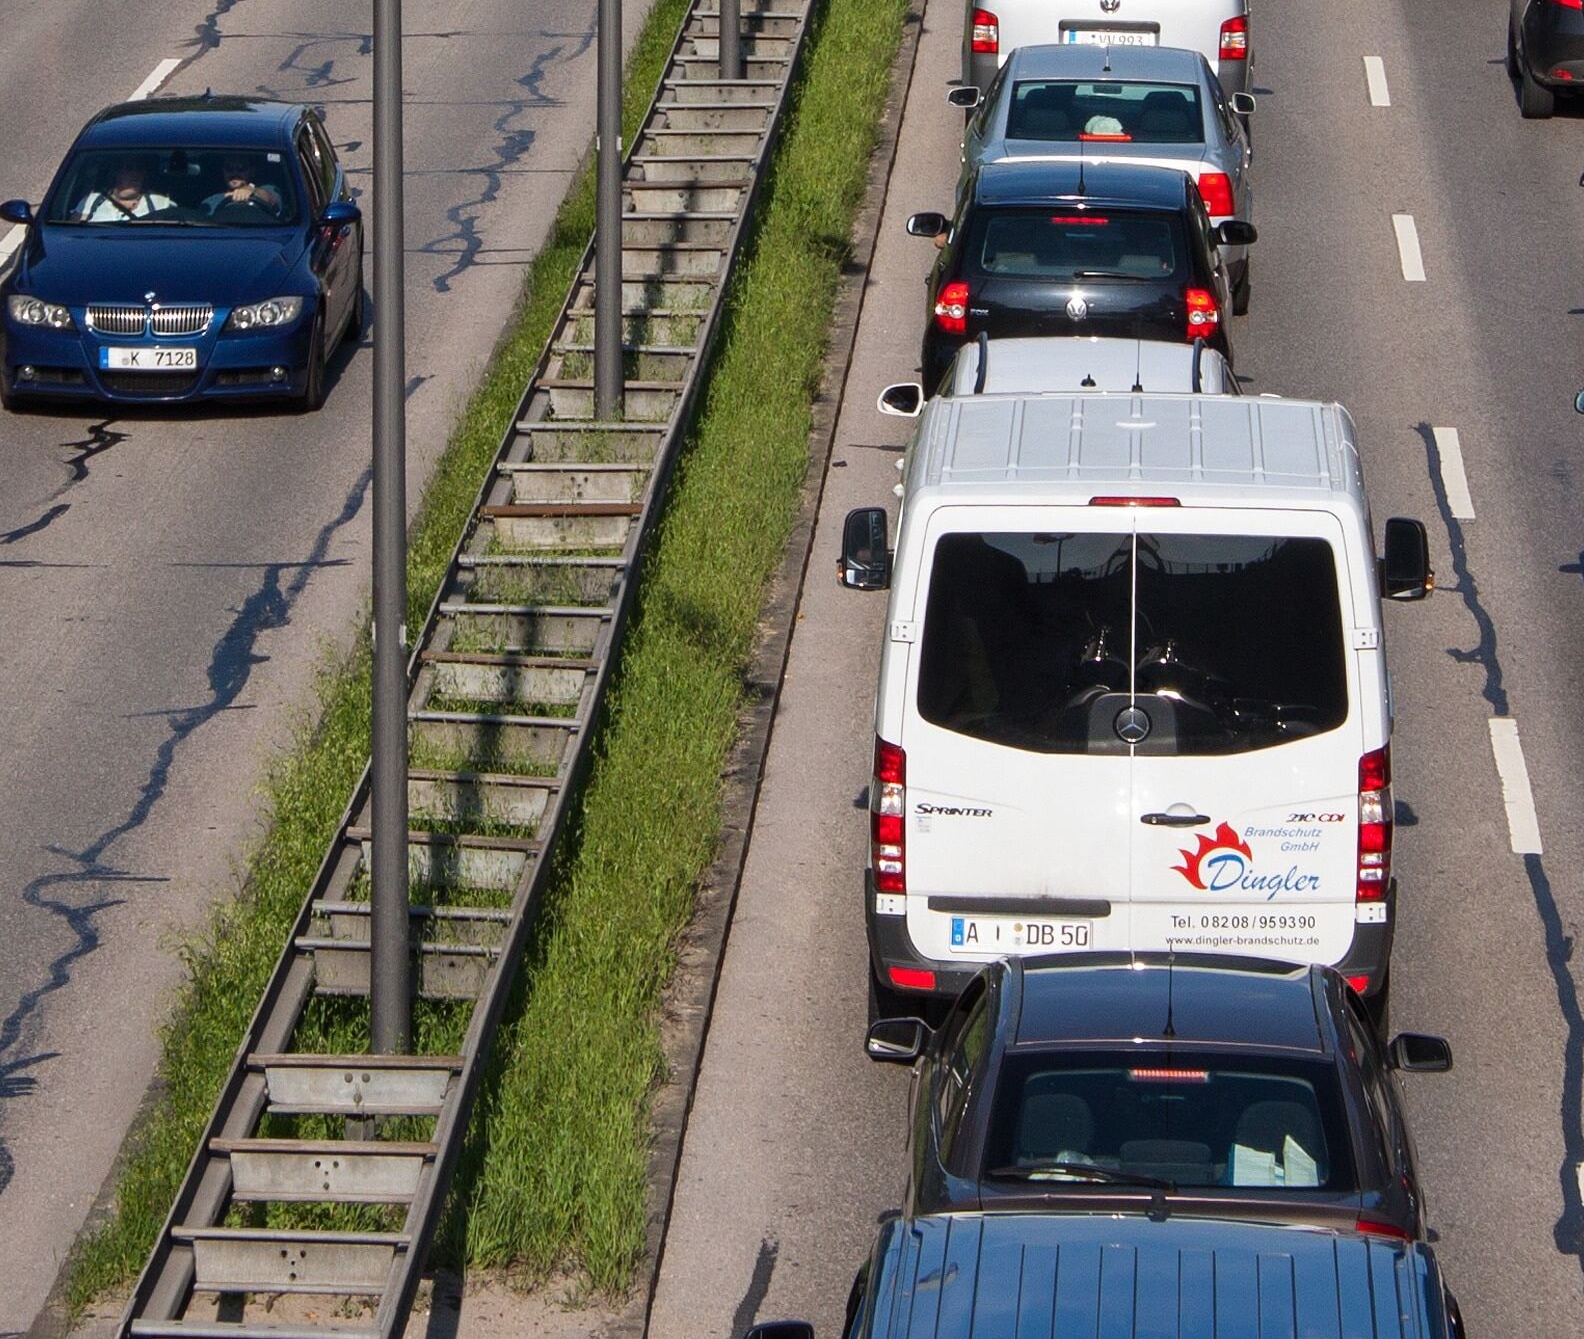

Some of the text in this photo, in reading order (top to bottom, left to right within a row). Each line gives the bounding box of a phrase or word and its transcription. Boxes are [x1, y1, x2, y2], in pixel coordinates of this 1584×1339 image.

[130, 351, 194, 366] K 7128
[915, 802, 993, 818] SPRINTER
[1318, 813, 1345, 822] CDI
[1244, 826, 1322, 838] Brandschutz
[1280, 841, 1320, 853] GmbH
[1206, 853, 1322, 901] Dingler
[1171, 915, 1196, 928] Tel.
[1026, 924, 1055, 945] DB
[1061, 925, 1088, 946] 50
[1166, 935, 1319, 948] www.dingler-brandschutz.de
